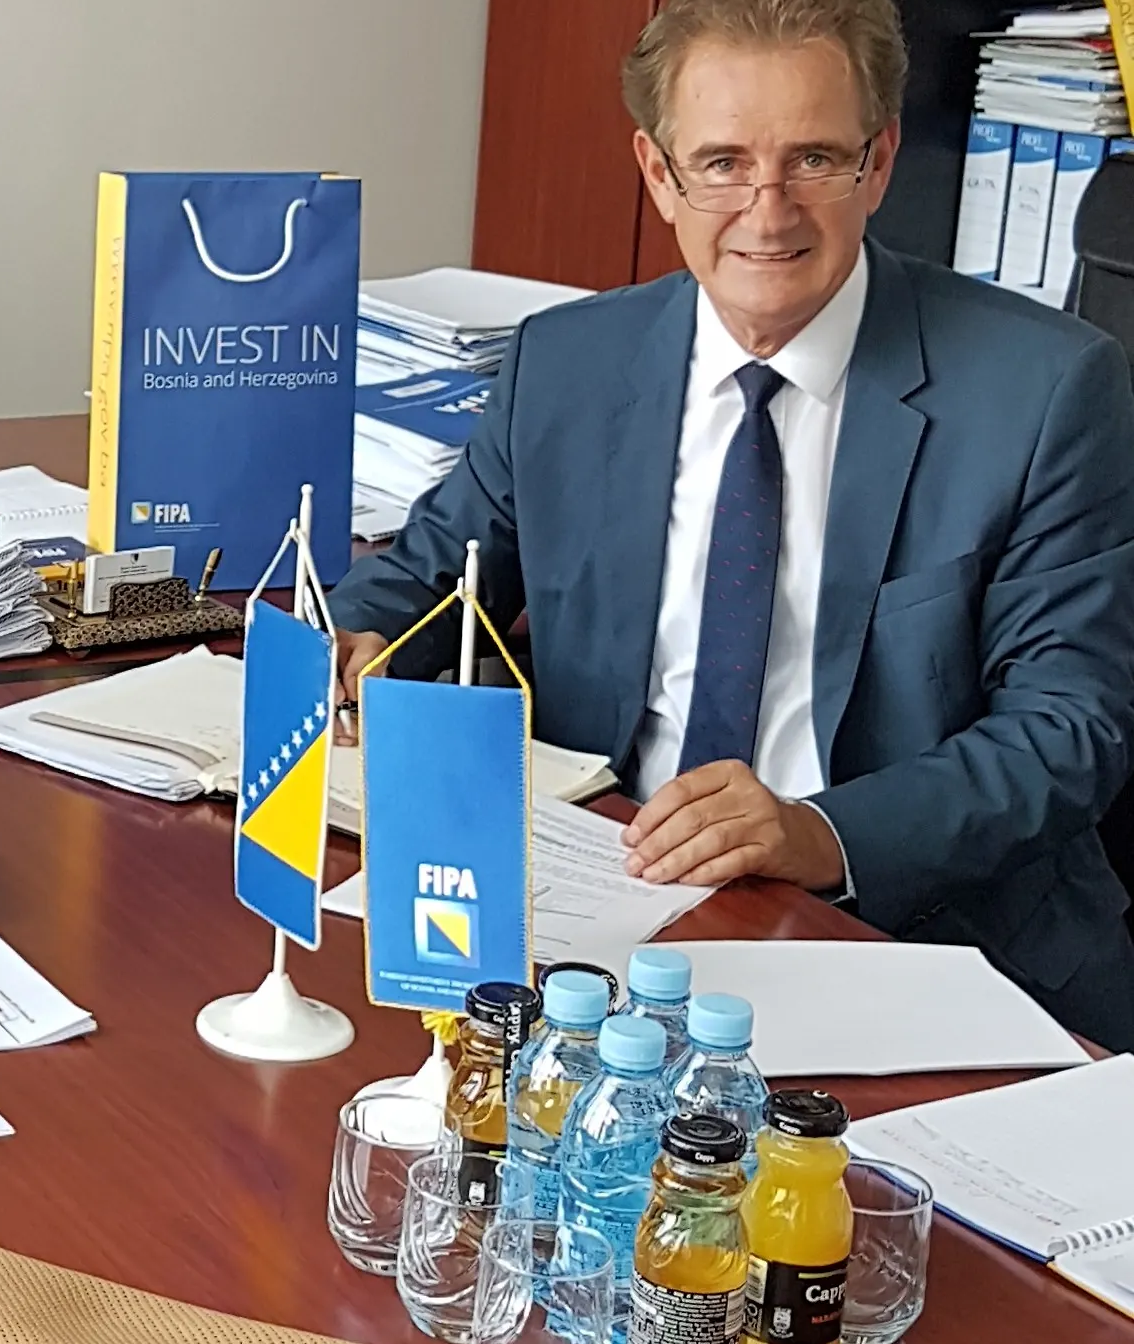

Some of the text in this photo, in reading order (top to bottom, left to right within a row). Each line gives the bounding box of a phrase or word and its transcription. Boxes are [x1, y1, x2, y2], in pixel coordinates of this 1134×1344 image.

[143, 323, 341, 366] INVEST IN
[143, 368, 338, 391] Bosnia and Herzegovina
[153, 503, 191, 524] FIPA
[418, 863, 478, 900] FIPA
[804, 1280, 848, 1305] Capp
